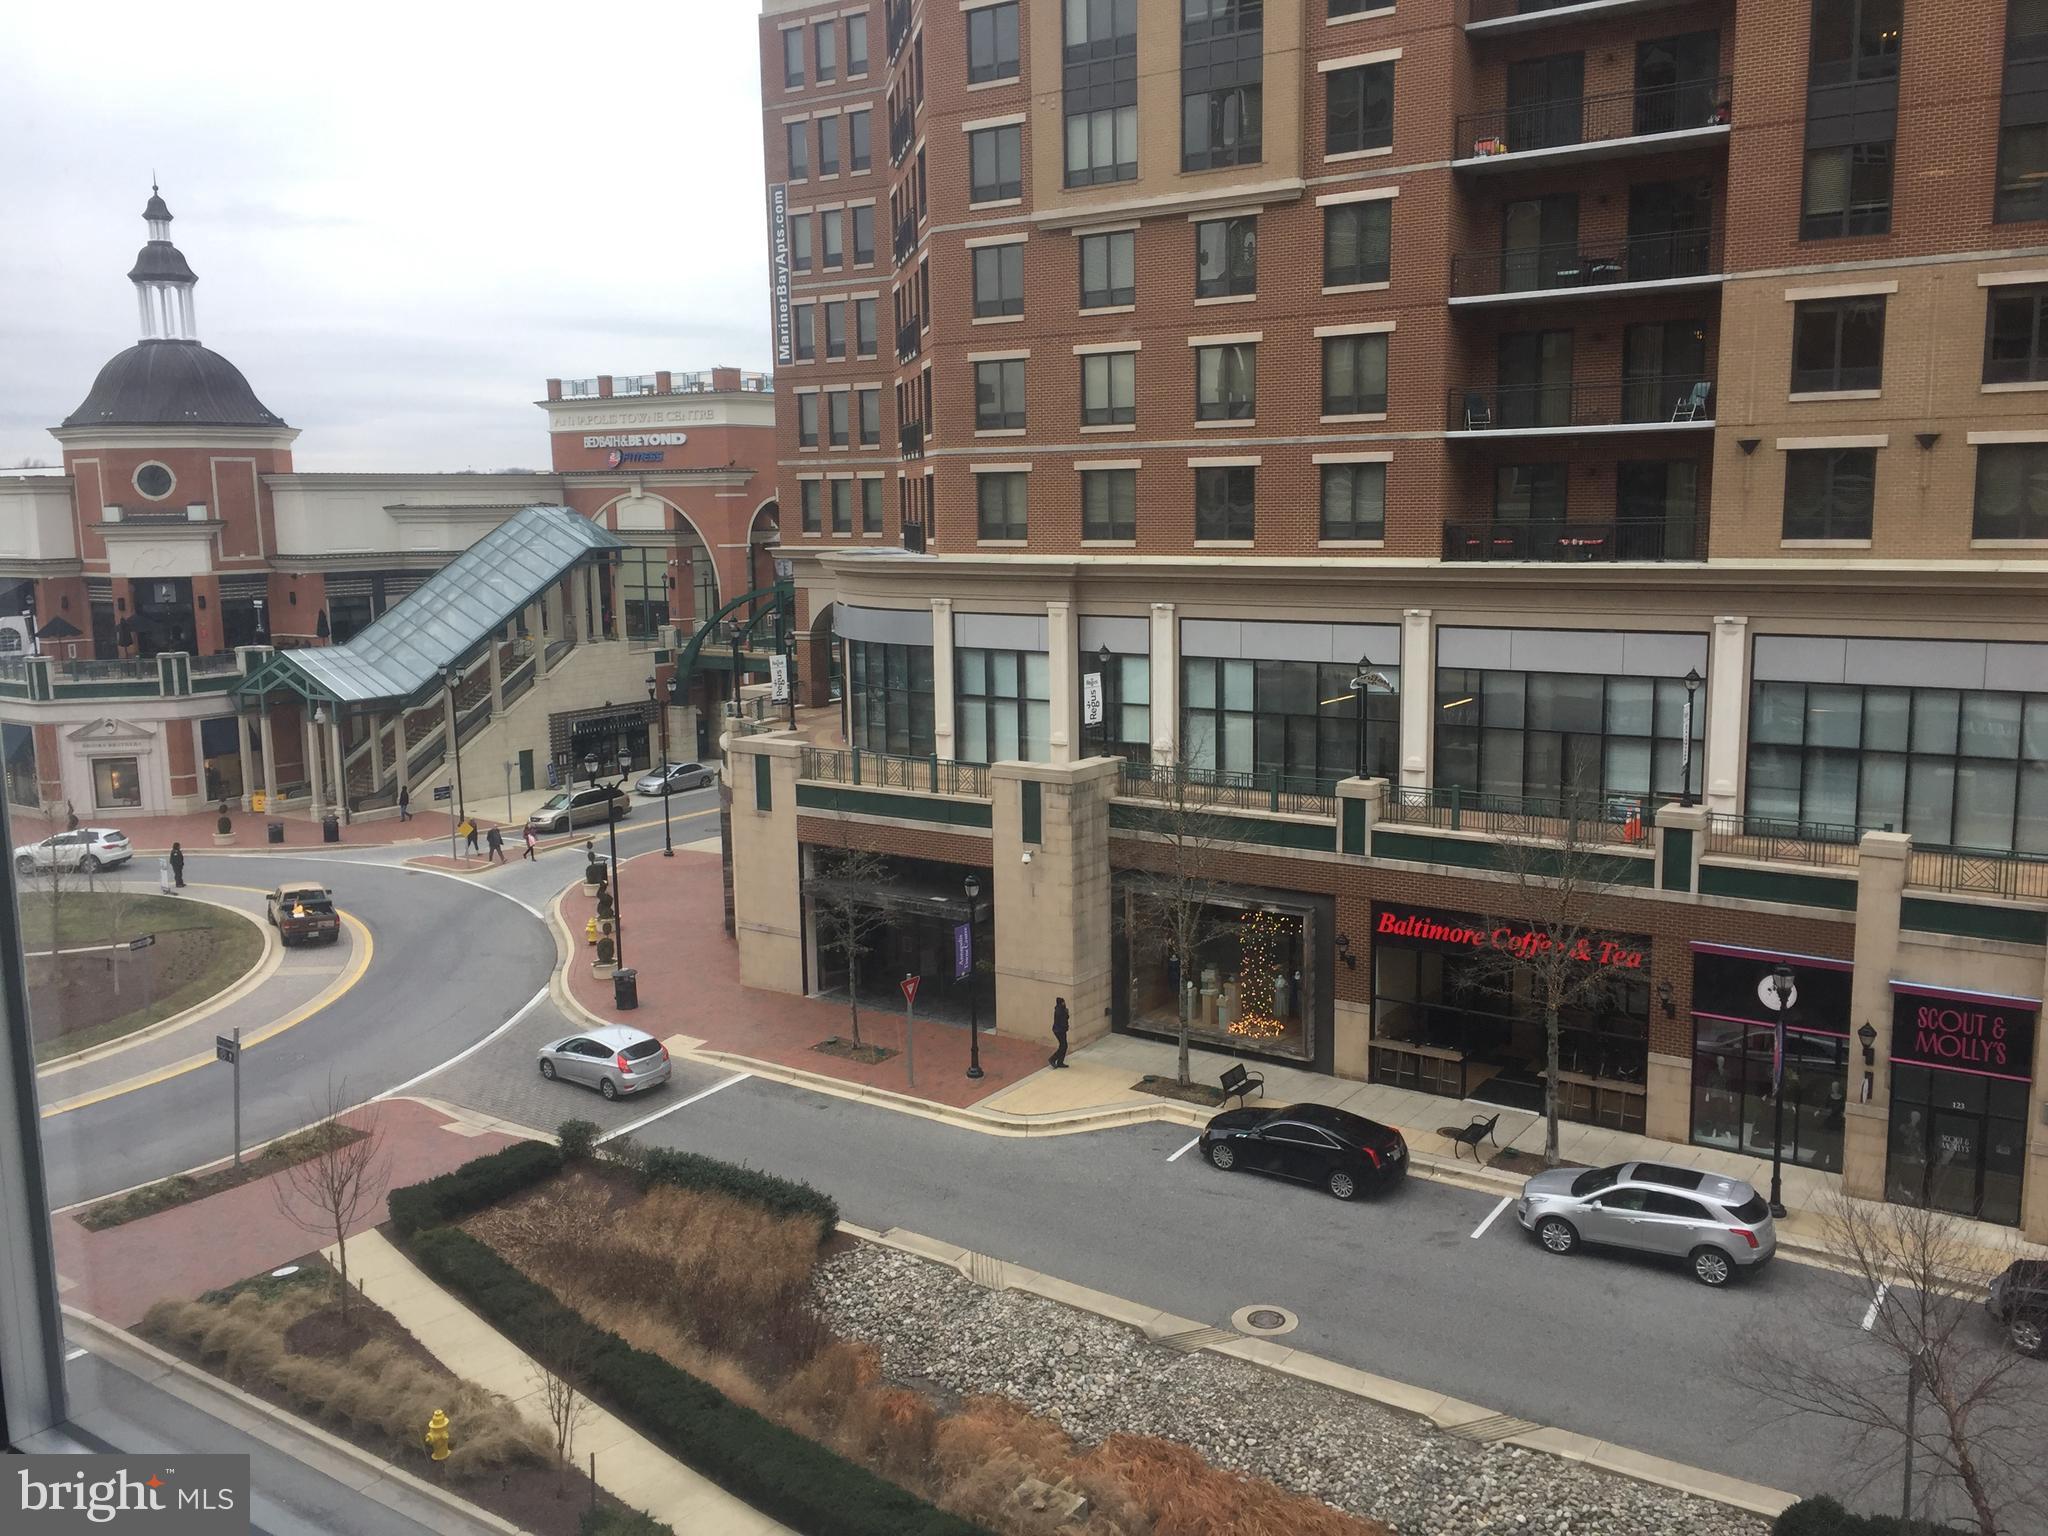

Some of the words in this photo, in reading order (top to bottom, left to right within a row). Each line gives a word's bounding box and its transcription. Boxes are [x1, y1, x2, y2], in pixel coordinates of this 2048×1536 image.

[774, 190, 790, 359] MarinerBayApts.com
[554, 414, 618, 427] ANNAPOLIS
[617, 411, 664, 425] TOWNE
[665, 409, 715, 422] CENTRE
[629, 432, 687, 447] BEYOND
[776, 669, 786, 697] Regus
[1089, 689, 1101, 720] Regus
[1377, 911, 1486, 946] Baltimore
[1569, 938, 1592, 961] &
[1600, 940, 1642, 969] Tea
[1917, 1006, 1988, 1036] SCOUT
[1991, 1016, 2007, 1039] &
[1915, 1031, 2007, 1065] MOLLY'S
[1952, 1101, 1965, 1110] 123
